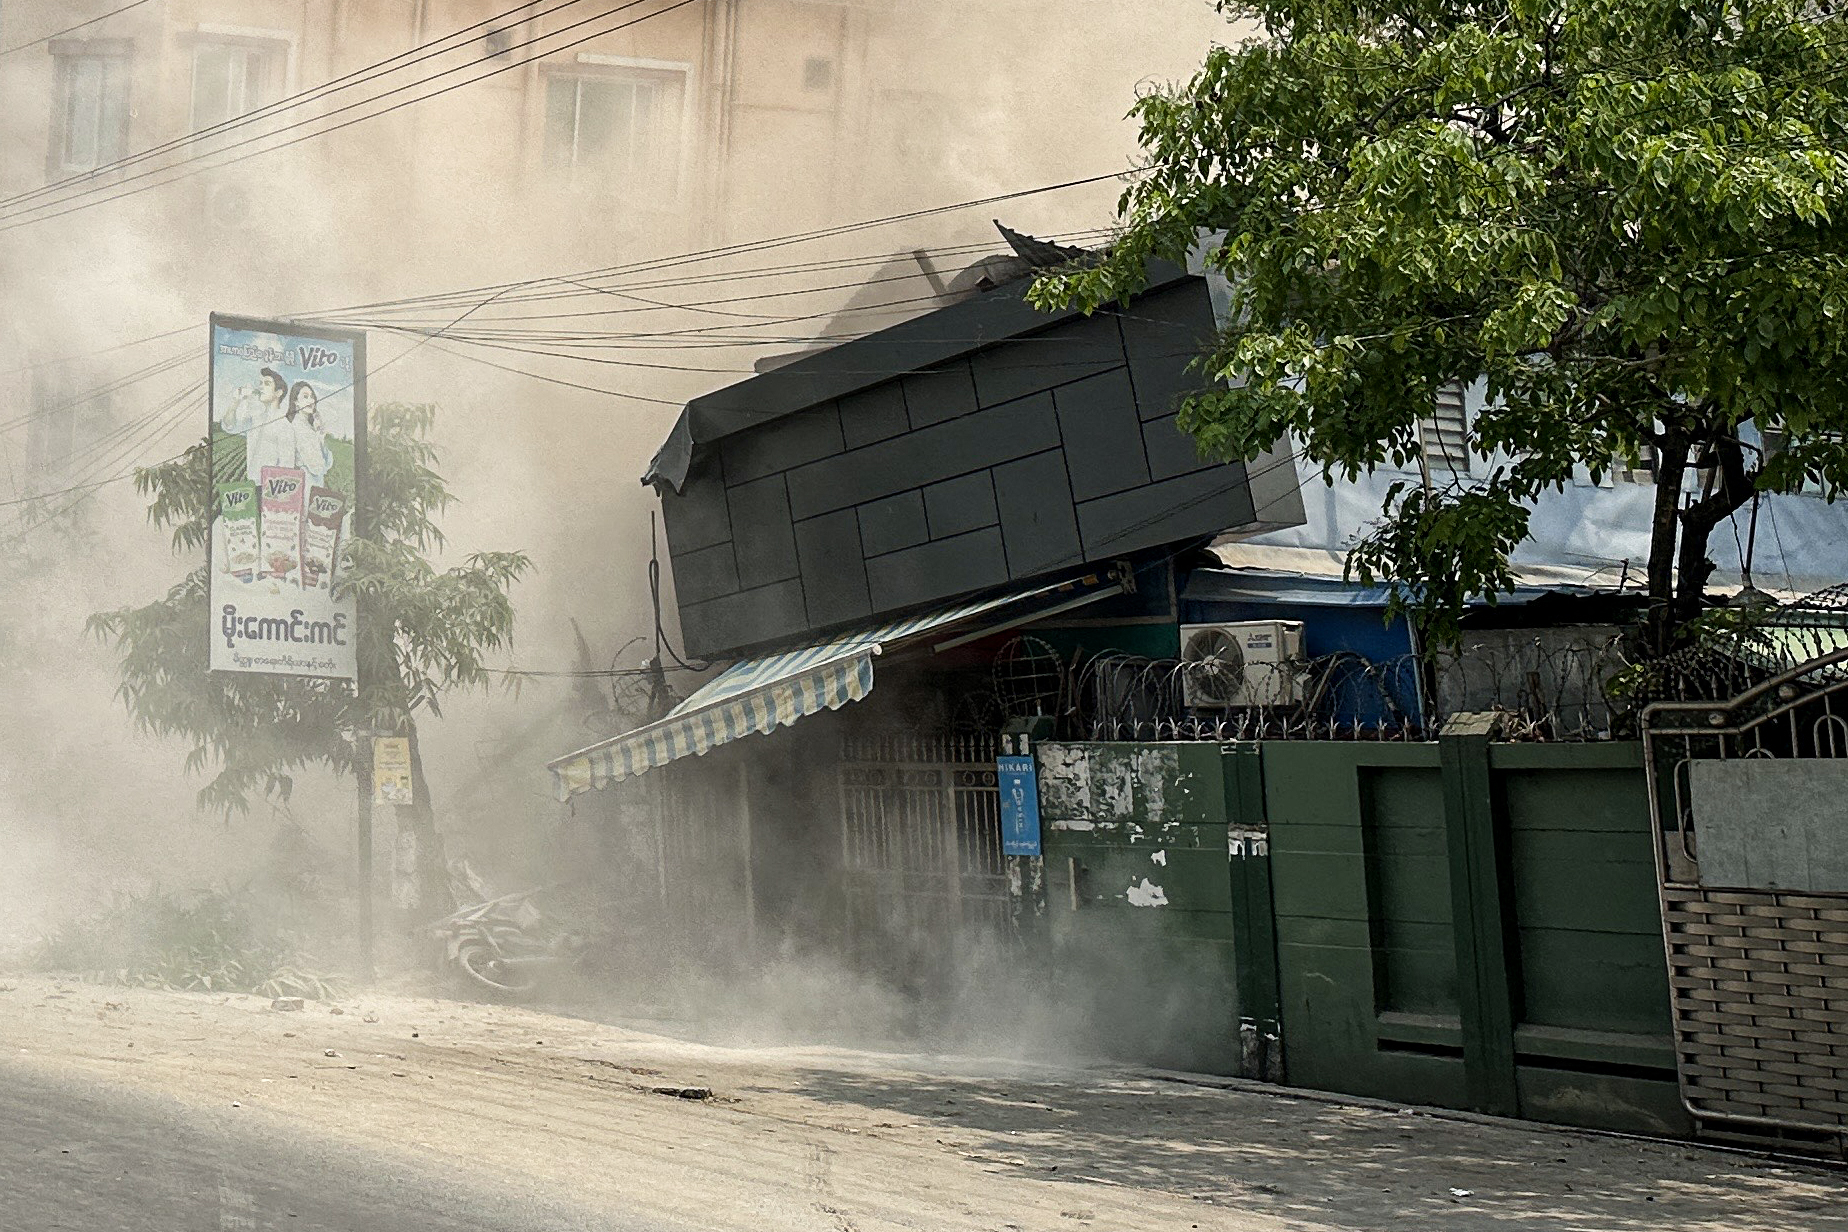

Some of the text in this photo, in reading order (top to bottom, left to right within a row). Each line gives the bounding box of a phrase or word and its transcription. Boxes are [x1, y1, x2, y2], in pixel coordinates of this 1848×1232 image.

[299, 346, 338, 370] Vito
[268, 478, 297, 496] Vito
[225, 491, 250, 508] Vito
[315, 497, 338, 512] Vito
[998, 763, 1033, 772] HIKARI
